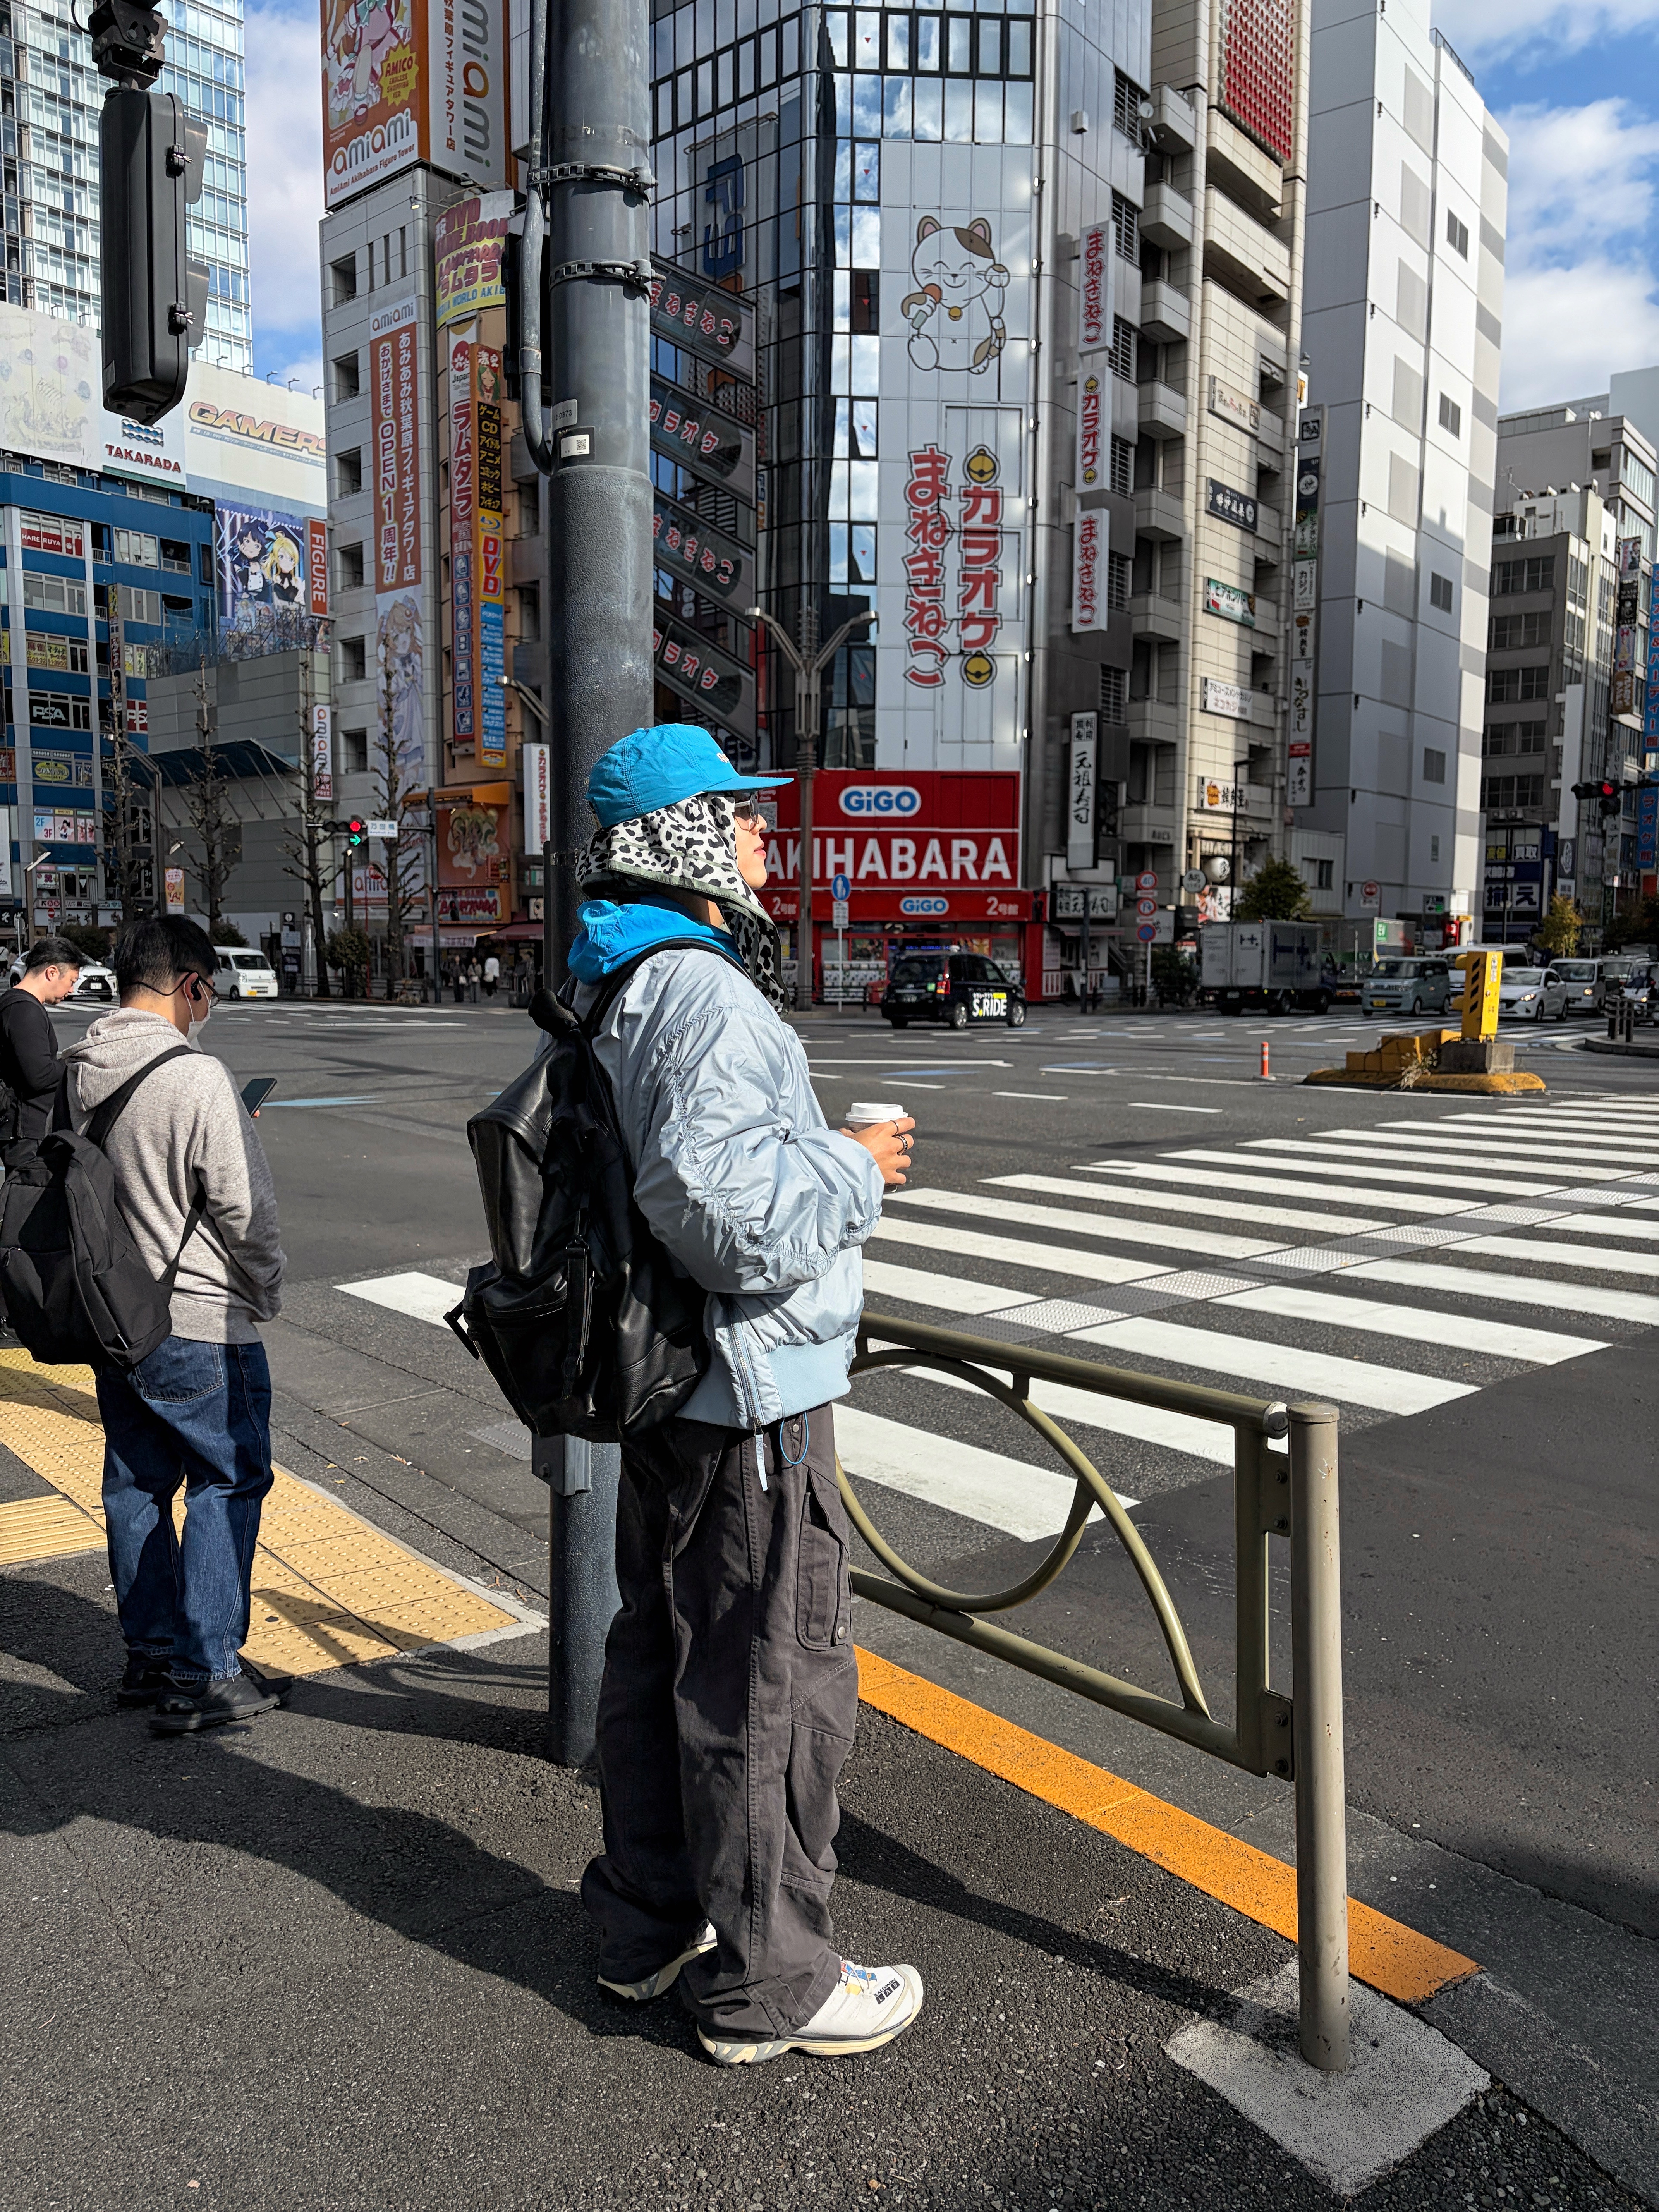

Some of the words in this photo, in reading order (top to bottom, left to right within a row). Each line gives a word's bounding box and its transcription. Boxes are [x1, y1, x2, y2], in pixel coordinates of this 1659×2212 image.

[385, 56, 413, 77] AMICO
[333, 111, 409, 175] amiami
[351, 165, 378, 184] Akihabara
[379, 154, 397, 169] Figure
[398, 143, 415, 158] Tower
[452, 289, 477, 307] WORLD
[1083, 227, 1106, 344] まねきねこ
[372, 302, 414, 331] amiami
[482, 421, 498, 434] CD
[1081, 393, 1101, 469] カラオケ
[105, 443, 181, 473] TAKARADA
[381, 423, 396, 492] OPEN
[398, 331, 416, 581] あみあみ秋葉原フィギュアタワー店
[480, 450, 500, 464] アニメ
[311, 533, 326, 603] FIGURE
[483, 536, 501, 597] DVD
[903, 445, 953, 688] まねきねこ
[959, 487, 1001, 650] カラオケ
[1078, 517, 1098, 626] まねきねこ
[33, 706, 66, 721] PSA
[844, 790, 917, 811] GiGO
[36, 817, 45, 827] 2F
[44, 829, 53, 838] 3F
[1639, 795, 1656, 862] ラオケ館
[764, 838, 1012, 880] AKIHABARA
[1142, 877, 1153, 885] 40
[902, 899, 946, 912] GiGO
[987, 896, 1019, 915] 2号館
[972, 999, 1007, 1017] S.RIDE
